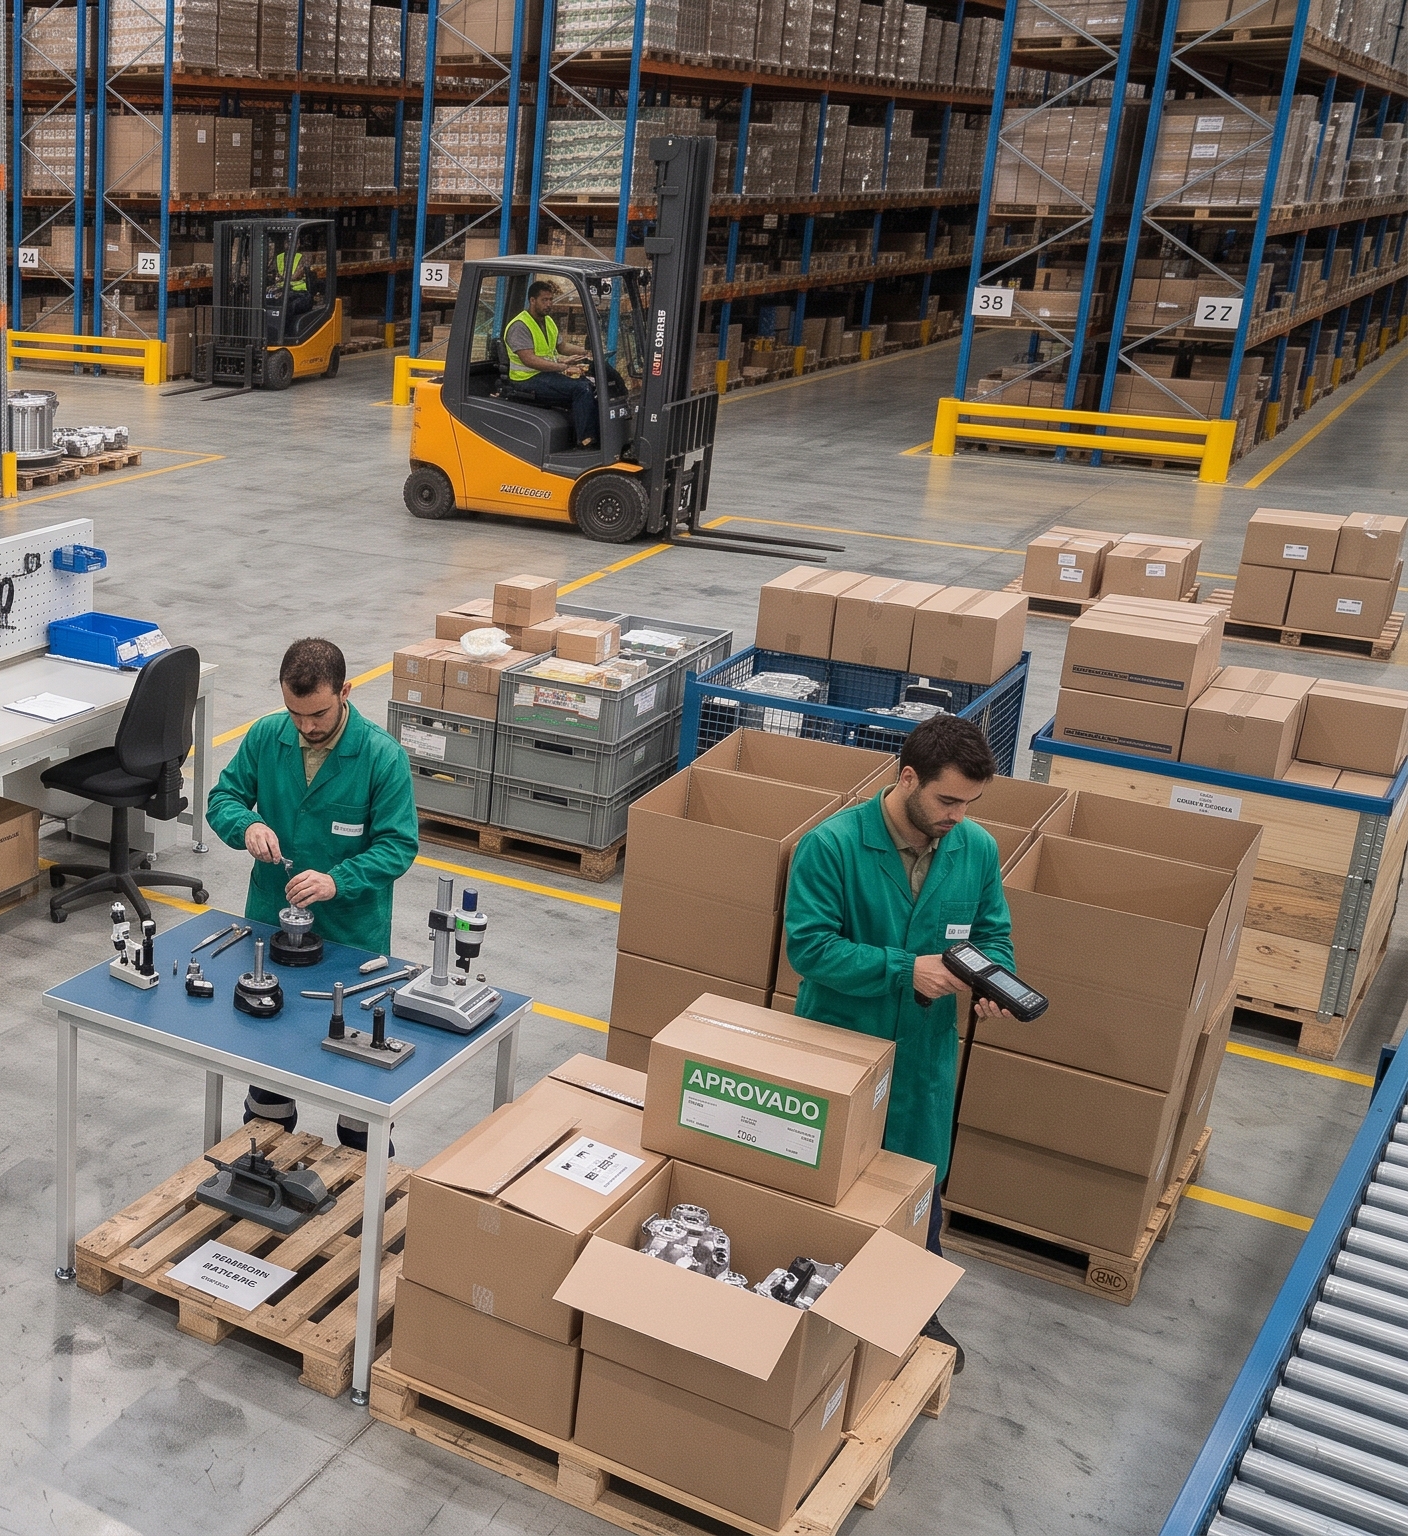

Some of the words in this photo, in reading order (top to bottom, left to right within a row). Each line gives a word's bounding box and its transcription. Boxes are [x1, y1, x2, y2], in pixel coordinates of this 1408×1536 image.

[22, 252, 35, 264] 24
[141, 258, 155, 270] 25
[425, 268, 443, 282] 35
[979, 294, 1003, 310] 38
[687, 1068, 820, 1121] APROVADO
[1095, 1270, 1122, 1288] BNC
